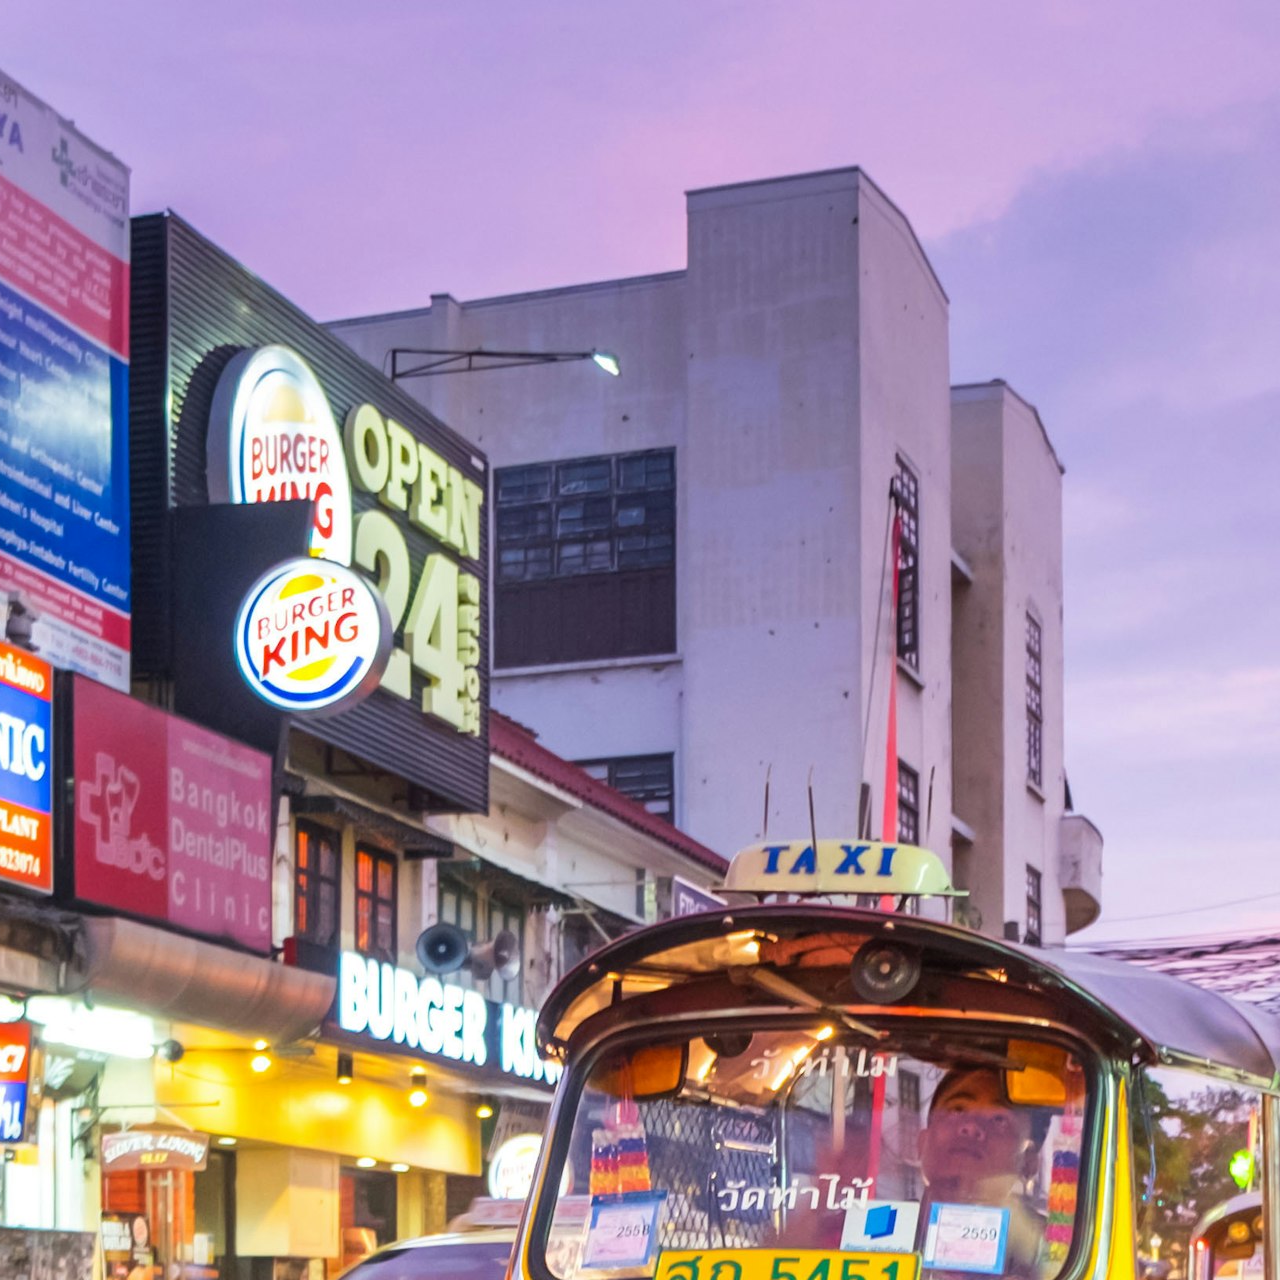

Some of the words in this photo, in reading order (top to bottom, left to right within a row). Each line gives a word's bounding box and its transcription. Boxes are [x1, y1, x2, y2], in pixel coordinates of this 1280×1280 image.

[251, 432, 330, 480] BURGER
[348, 403, 484, 561] OPEN
[30, 508, 64, 538] Hospital
[94, 511, 120, 536] Center
[101, 578, 128, 600] Center
[257, 586, 356, 641] BURGER
[261, 611, 360, 679] KING
[353, 511, 465, 731] 24
[170, 766, 269, 836] Bangkok
[170, 817, 269, 882] DentalPlus
[761, 844, 898, 877] TAXI
[170, 870, 269, 932] Clinic
[337, 949, 489, 1067] BURGER
[717, 1173, 876, 1211] วัดท่าไม้
